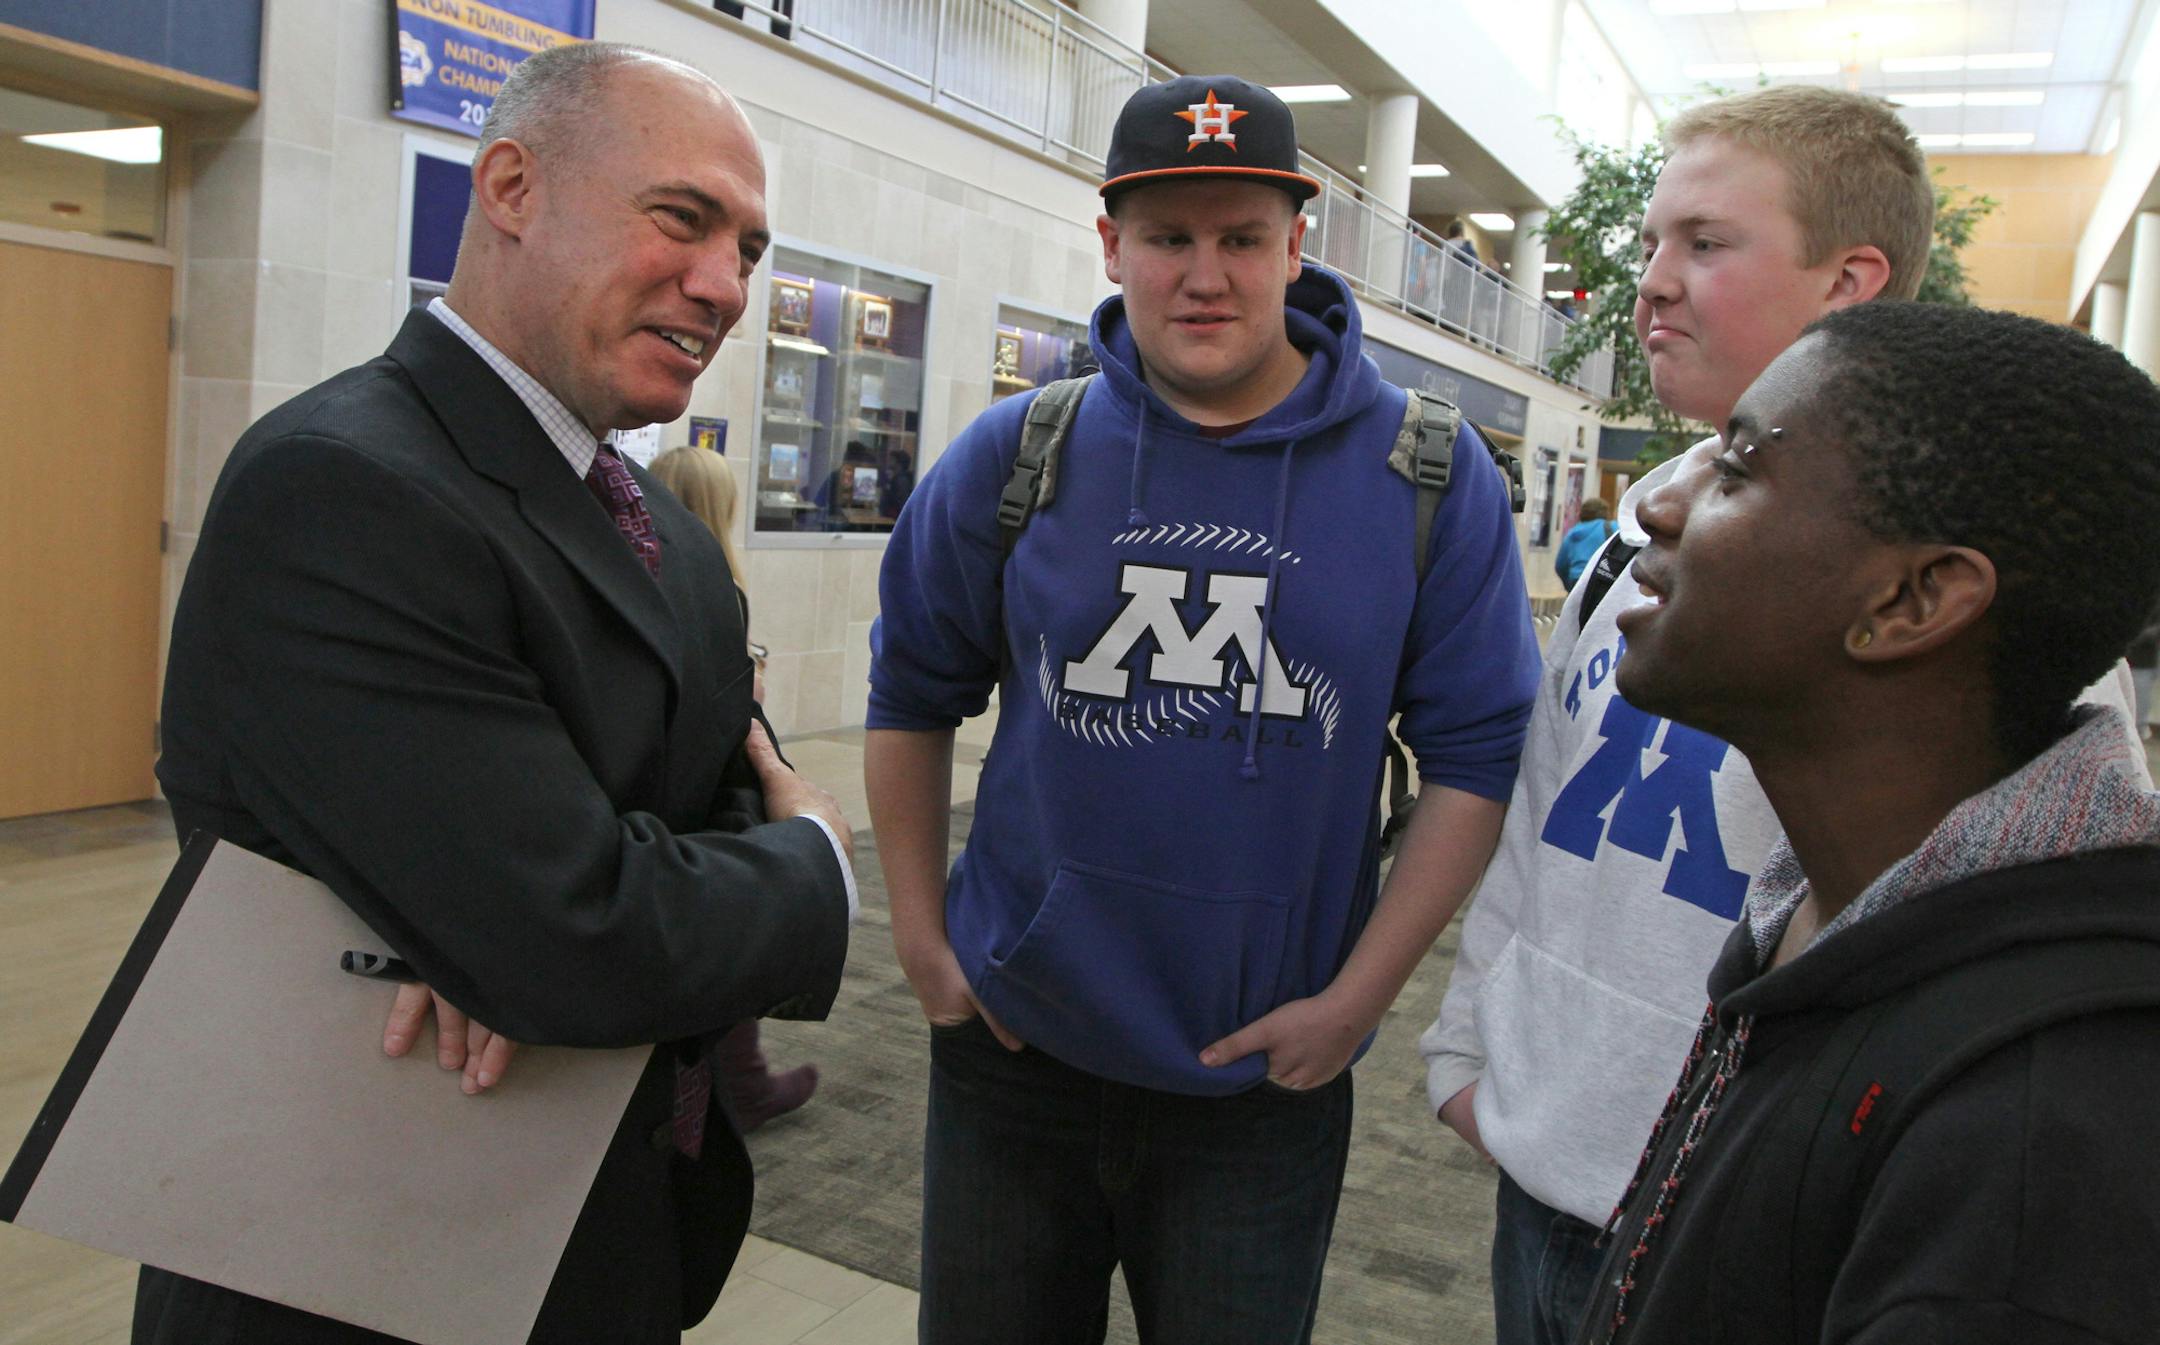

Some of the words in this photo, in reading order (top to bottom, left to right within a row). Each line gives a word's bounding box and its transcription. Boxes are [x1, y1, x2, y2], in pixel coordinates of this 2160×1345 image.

[465, 6, 555, 48] TUMBLING
[459, 99, 492, 126] 20
[1187, 103, 1236, 143] H
[1060, 562, 1308, 720] M
[1541, 694, 1751, 922] M
